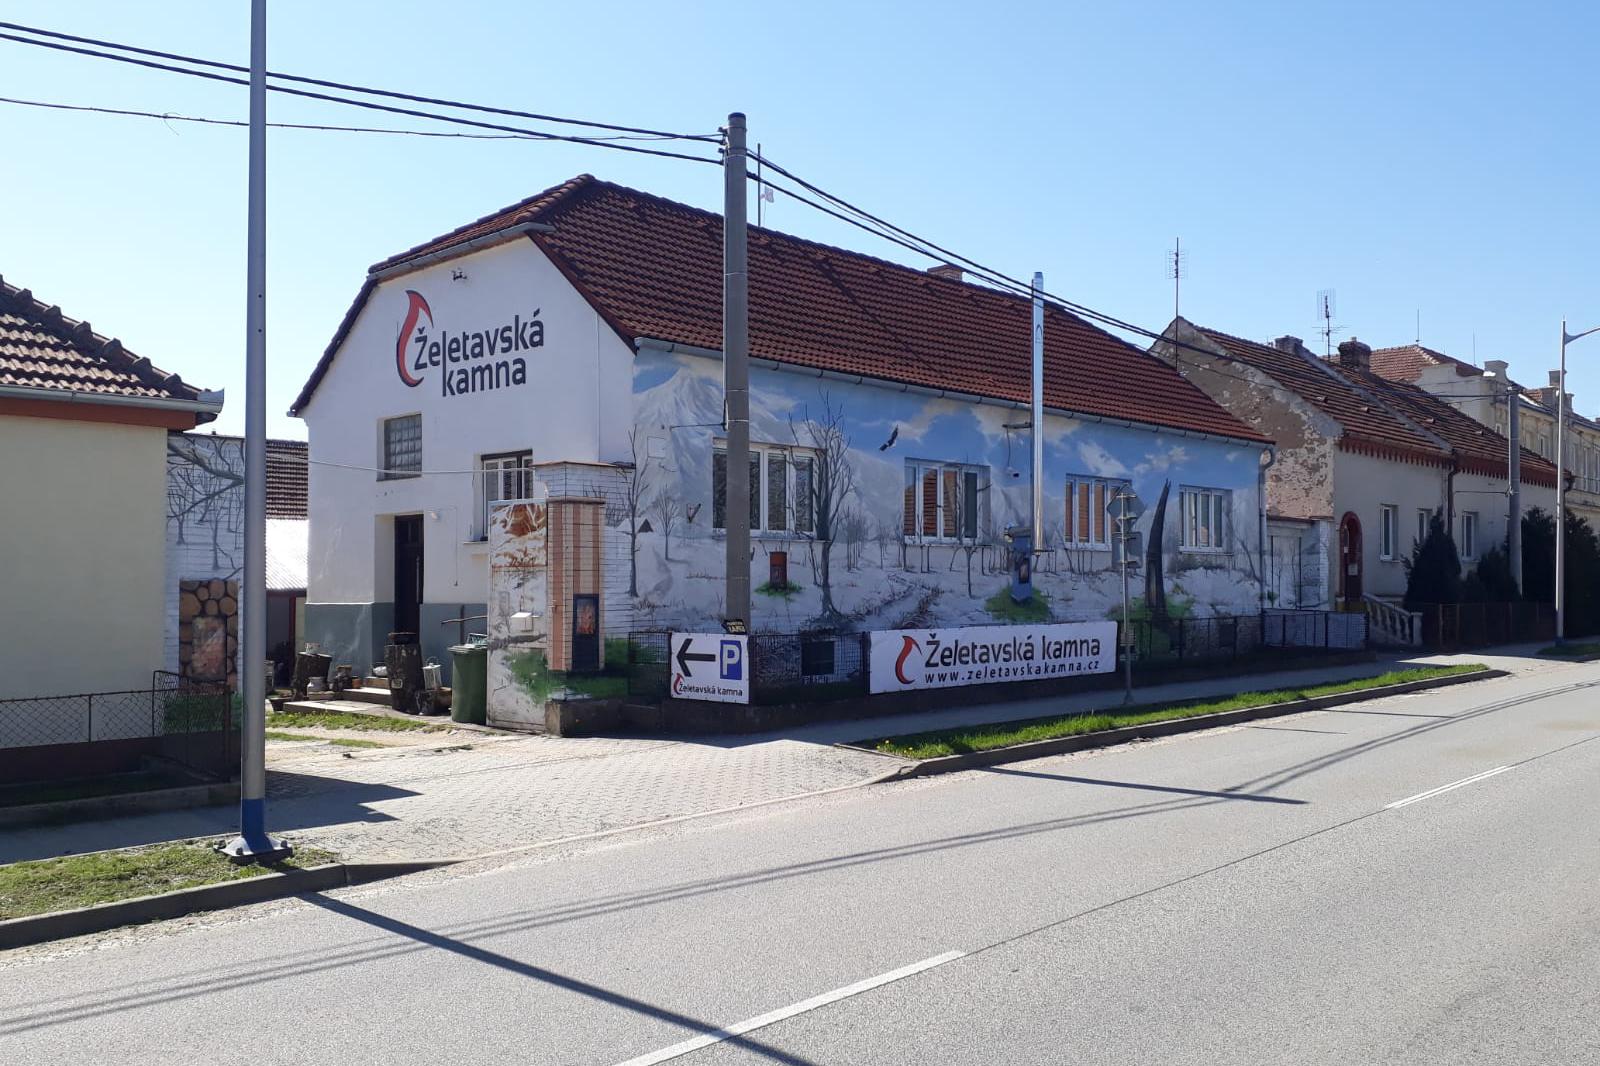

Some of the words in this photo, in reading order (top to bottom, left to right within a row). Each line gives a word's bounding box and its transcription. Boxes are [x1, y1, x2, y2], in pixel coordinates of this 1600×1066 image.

[414, 307, 545, 371] Želetavská
[442, 356, 527, 397] kamna
[722, 643, 741, 676] P
[924, 632, 1035, 668] Želetavská
[1041, 635, 1101, 660] kamna
[924, 659, 1100, 684] www.zeletavskakamna.cz
[679, 681, 716, 695] Želetavská
[717, 686, 743, 697] kamna
